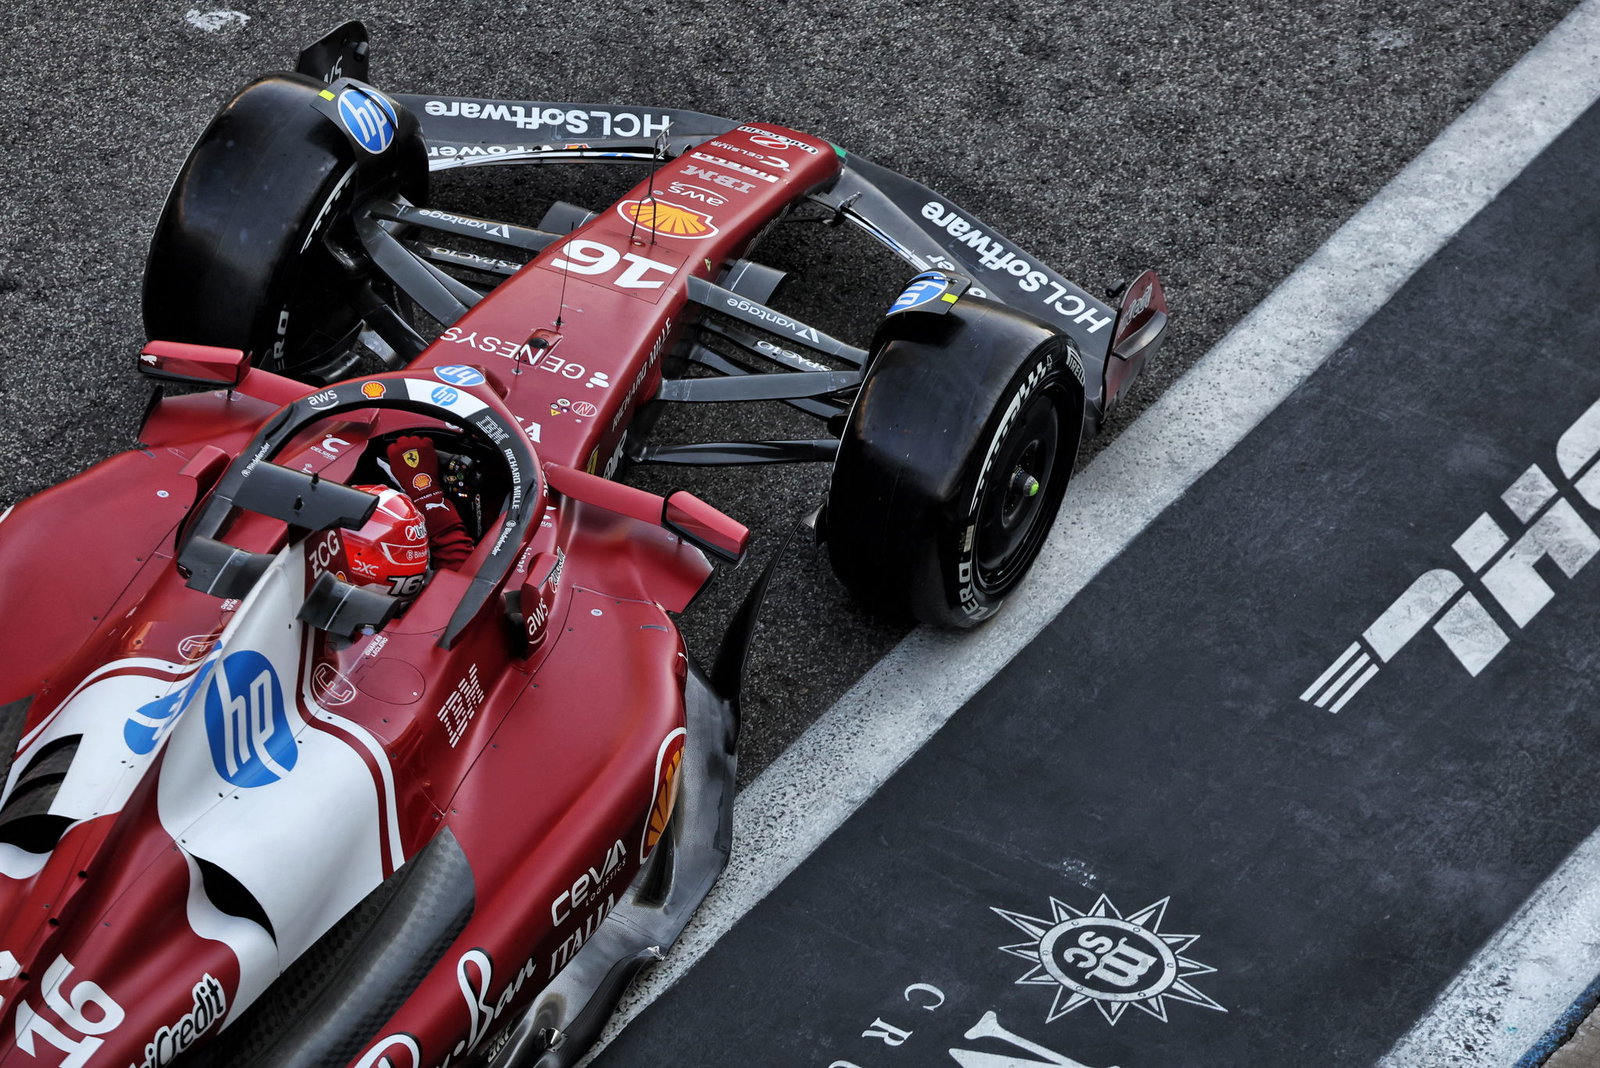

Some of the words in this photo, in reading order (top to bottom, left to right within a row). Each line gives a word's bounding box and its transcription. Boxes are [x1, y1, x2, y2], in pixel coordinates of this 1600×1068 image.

[340, 91, 396, 152] hp
[425, 100, 670, 138] HCLSoftware
[680, 164, 756, 193] IBM
[690, 152, 779, 183] PIRELLI
[668, 184, 726, 207] aws
[550, 239, 678, 289] 16
[921, 201, 1112, 333] HCLSoftware
[273, 311, 289, 370] RO
[440, 326, 586, 379] GENESYS
[756, 340, 832, 371] SPACIO
[436, 365, 485, 386] hp
[307, 389, 338, 407] aws
[431, 386, 458, 406] hp
[476, 415, 510, 445] IBM
[504, 448, 521, 484] RICHARD
[512, 485, 521, 510] MILLE
[526, 598, 549, 636] aws
[209, 655, 295, 783] hp
[437, 663, 485, 748] IBM
[15, 952, 125, 1068] 16
[129, 972, 227, 1068] iCredit
